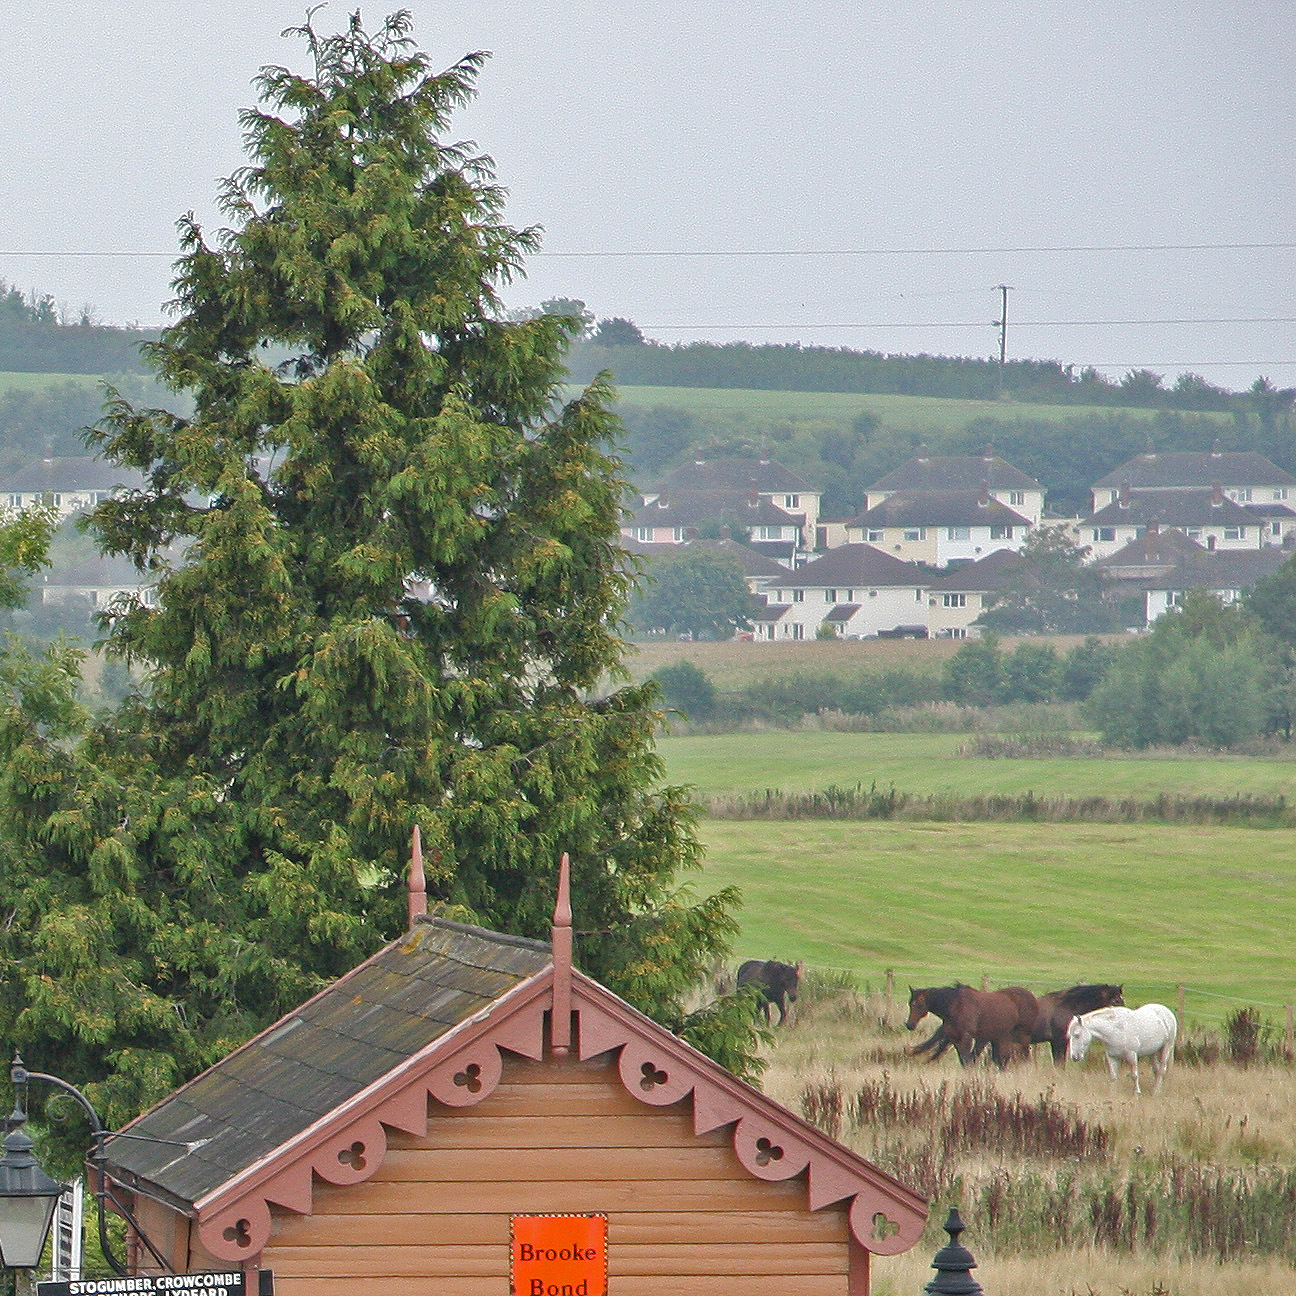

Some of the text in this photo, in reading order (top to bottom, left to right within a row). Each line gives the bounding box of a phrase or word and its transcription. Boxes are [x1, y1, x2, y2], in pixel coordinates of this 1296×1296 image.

[520, 1243, 596, 1261] Brooke
[156, 1273, 242, 1290] CROWCOMBE
[529, 1279, 588, 1296] Bond
